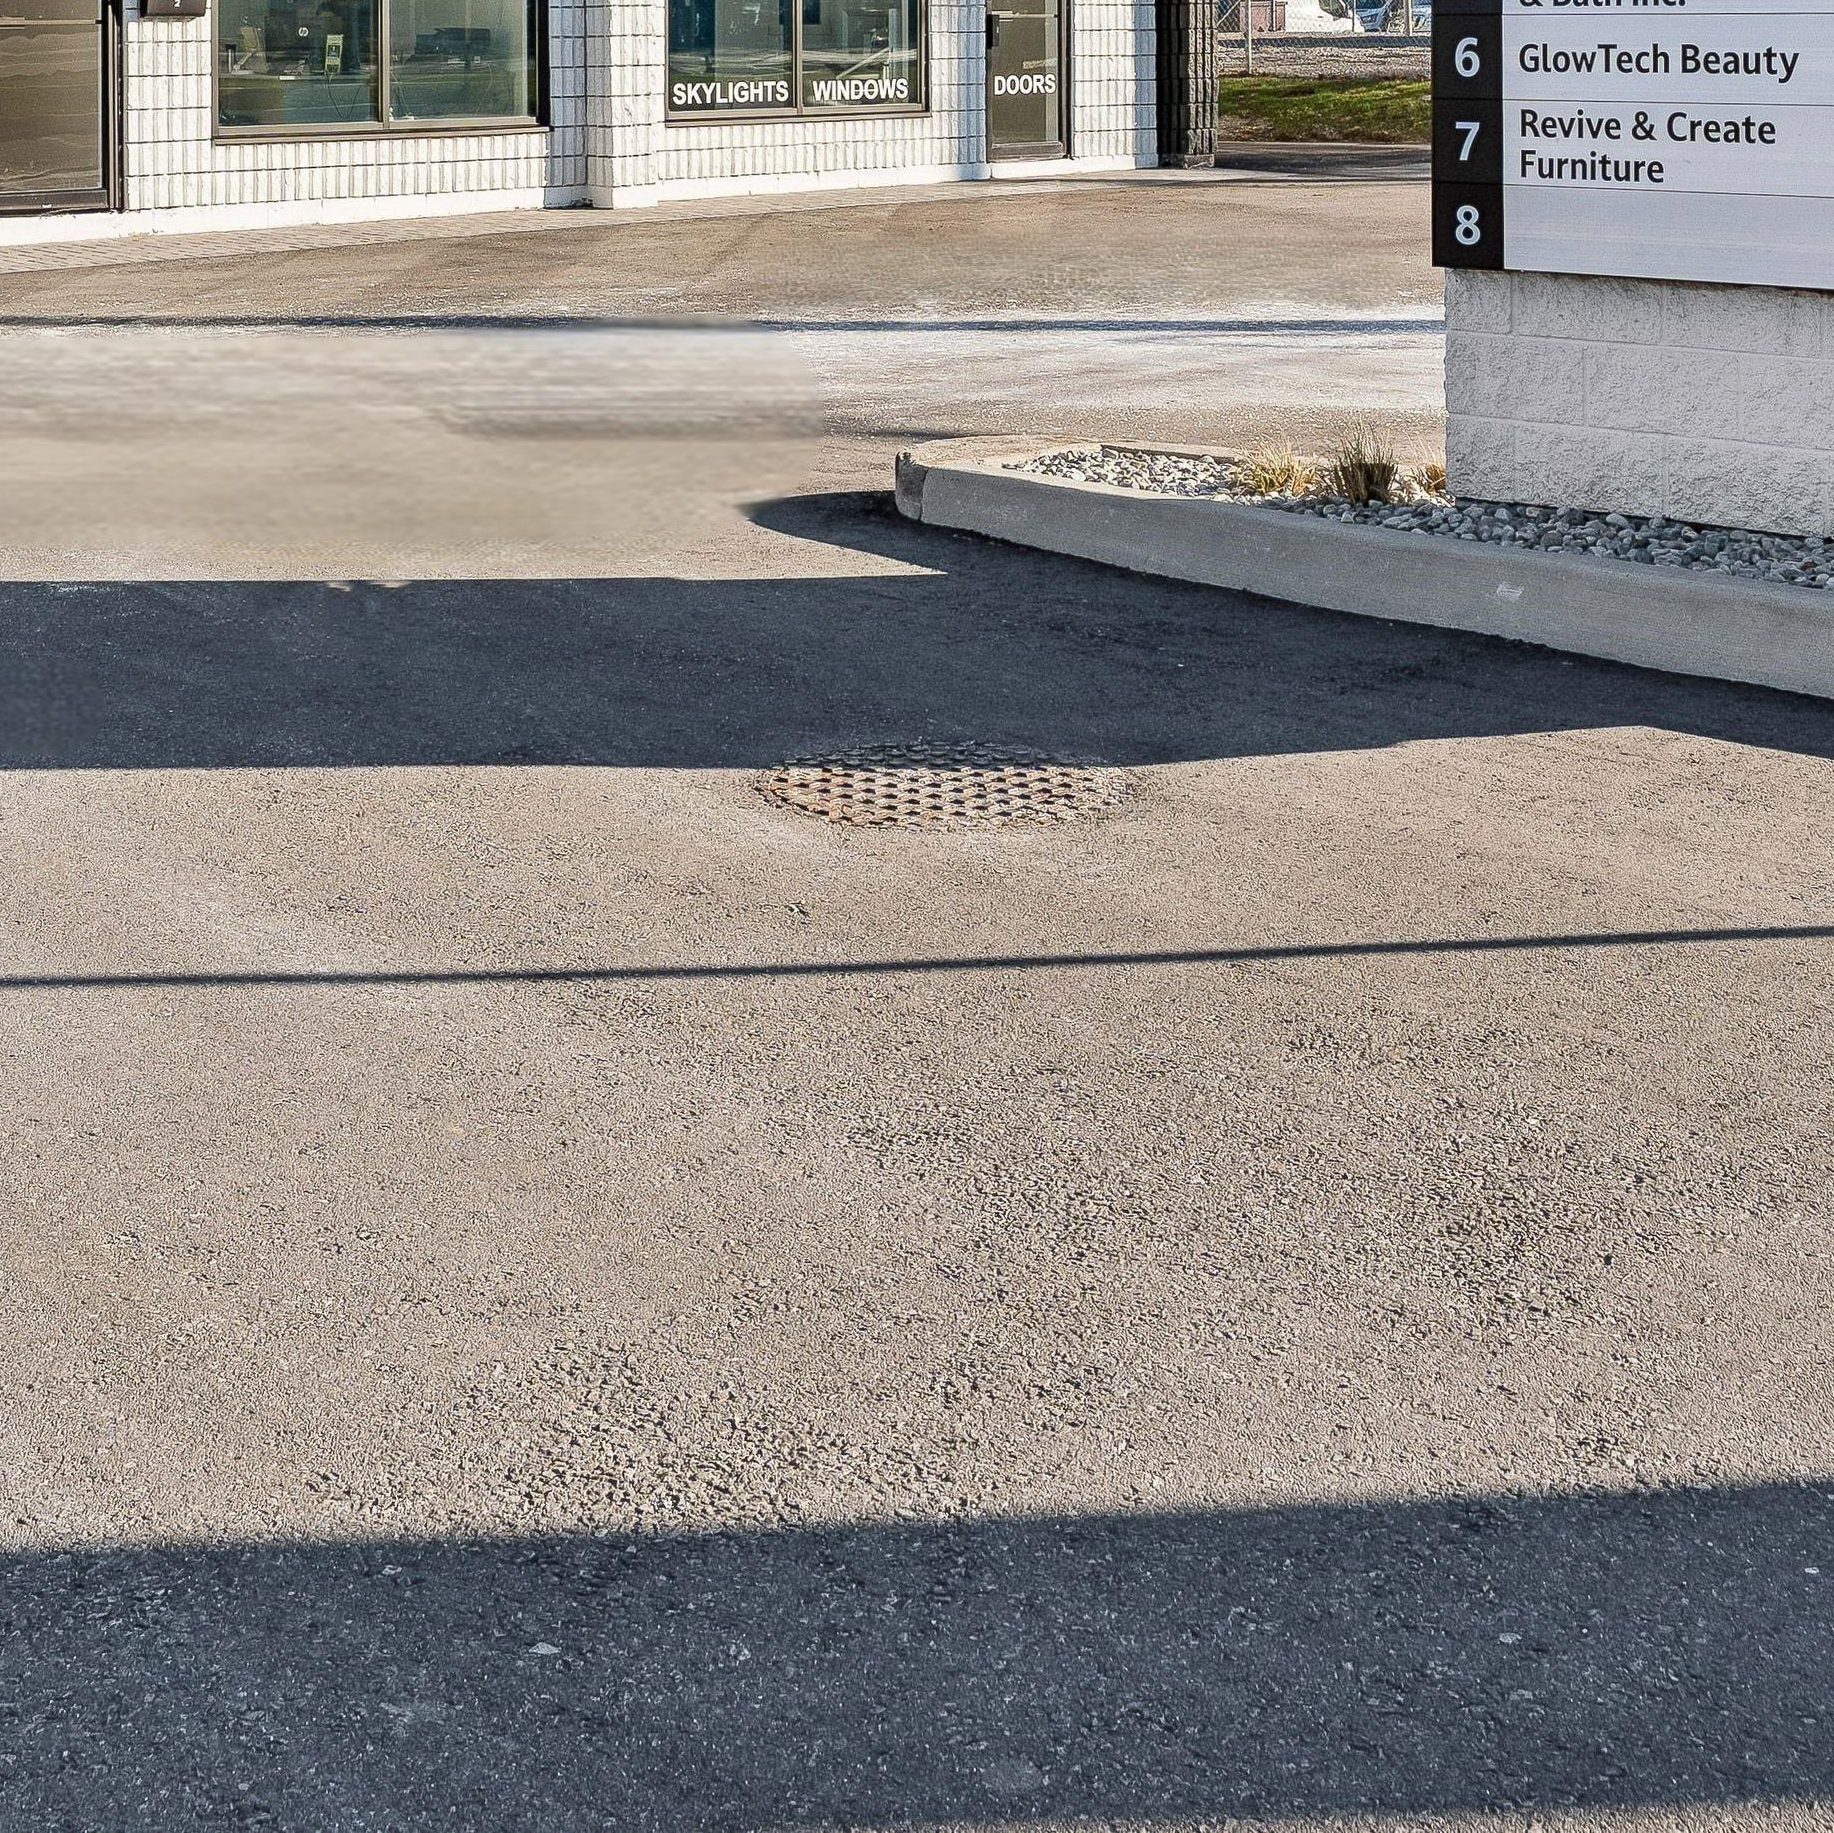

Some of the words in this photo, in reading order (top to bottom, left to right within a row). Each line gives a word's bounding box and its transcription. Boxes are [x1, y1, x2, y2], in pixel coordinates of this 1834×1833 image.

[1454, 36, 1480, 78] 6
[1519, 43, 1670, 74] GlowTech
[1681, 43, 1800, 84] Beauty
[672, 80, 790, 106] SKYLIGHTS
[811, 77, 910, 103] WINDOWS
[994, 73, 1056, 96] DOORS
[1455, 121, 1480, 161] 7
[1520, 108, 1622, 140] Revive
[1631, 110, 1658, 141] &
[1666, 111, 1776, 145] Create
[1520, 149, 1664, 184] Furniture
[1455, 204, 1481, 246] 8
